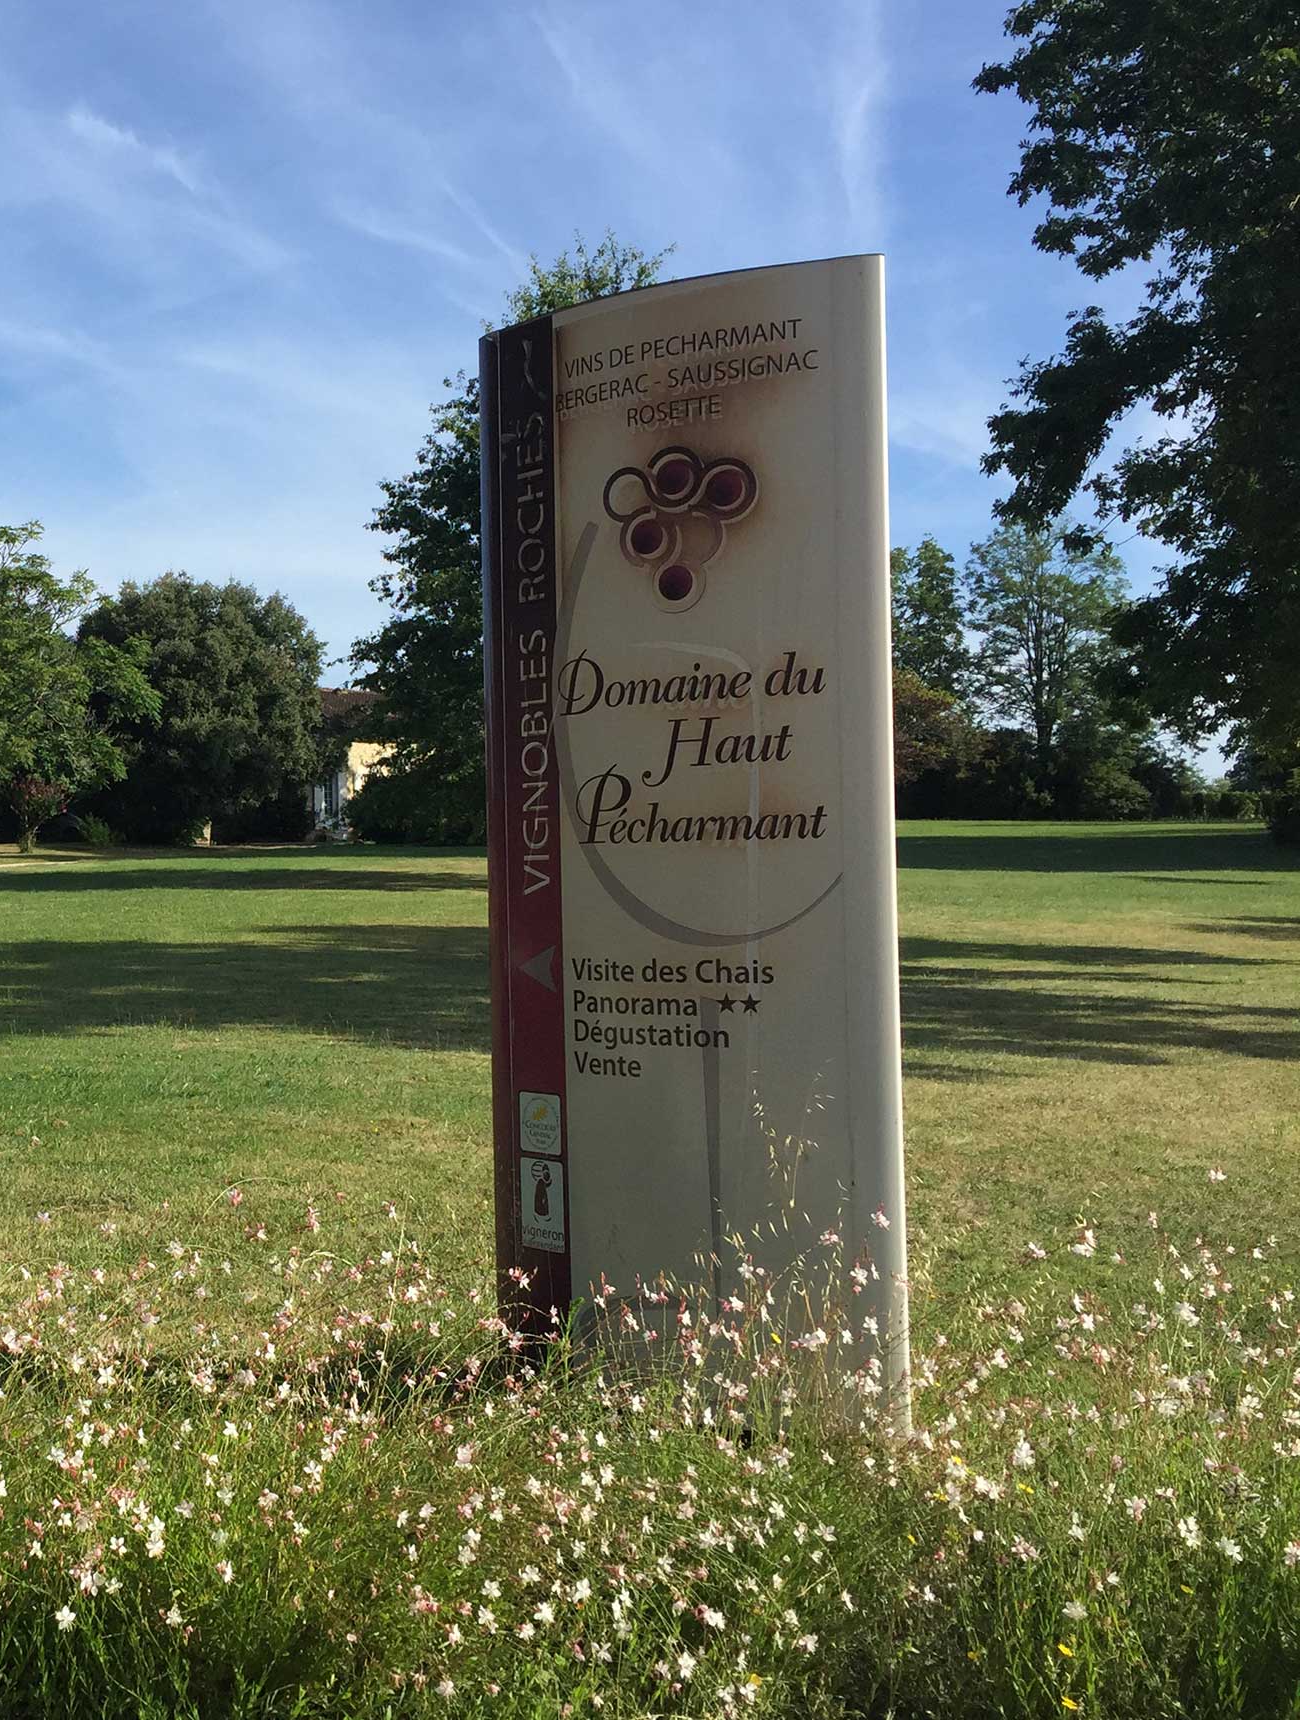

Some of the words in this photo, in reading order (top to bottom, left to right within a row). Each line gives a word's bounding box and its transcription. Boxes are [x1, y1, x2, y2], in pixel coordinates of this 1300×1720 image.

[564, 352, 604, 379] VINS
[609, 344, 635, 369] DE
[640, 318, 803, 363] PECHARMANT
[555, 374, 650, 413] BERGERAC
[667, 350, 819, 389] SAUSSIGNAC
[627, 395, 721, 427] ROSETTE
[517, 412, 546, 604] ROCHES
[557, 648, 752, 717] Domaine
[764, 651, 827, 696] du
[519, 628, 551, 896] VIGNOBLES
[641, 716, 794, 788] Haut
[576, 763, 828, 846] Pécharmant
[571, 957, 635, 983] Visite
[641, 958, 688, 983] des
[695, 959, 775, 985] Chais
[573, 989, 699, 1017] Panorama
[574, 1019, 731, 1050] Dégustation
[574, 1051, 642, 1078] Vente
